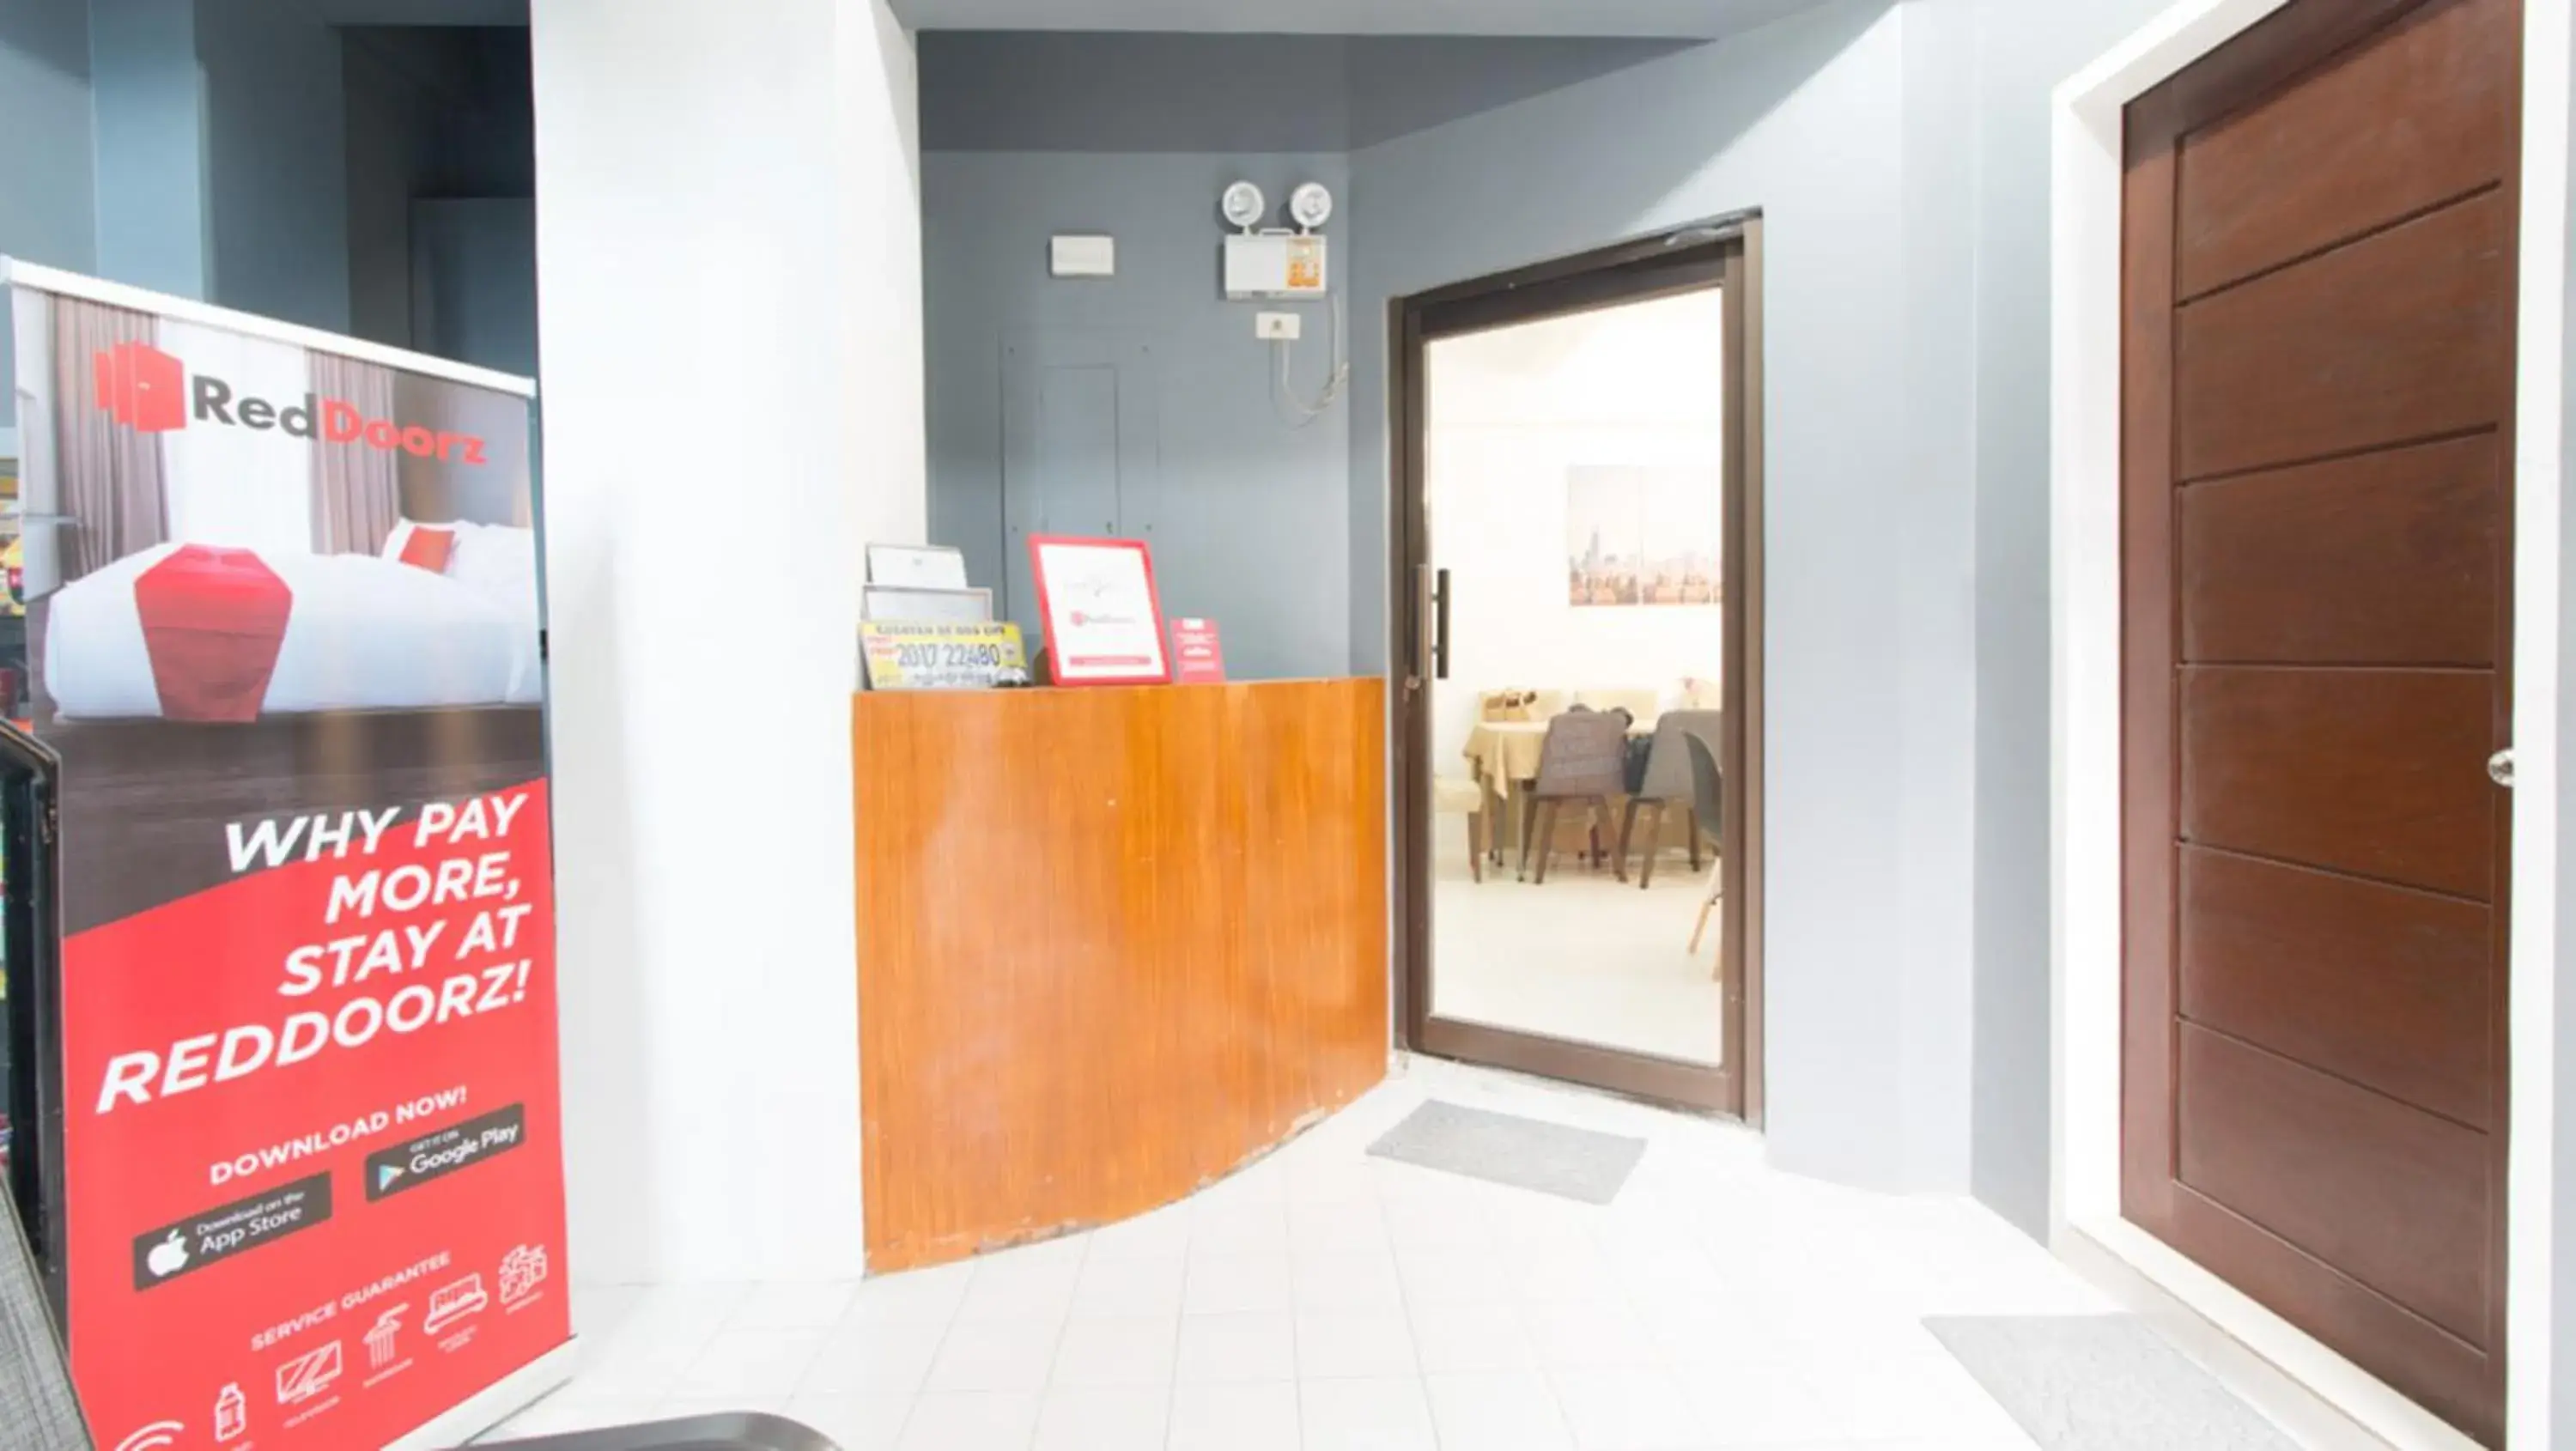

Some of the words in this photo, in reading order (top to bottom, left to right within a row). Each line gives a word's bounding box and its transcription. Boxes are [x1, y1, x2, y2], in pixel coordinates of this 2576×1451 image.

[193, 375, 487, 464] RedDoorz
[226, 805, 401, 873] WHY
[415, 792, 529, 847] PAY
[325, 852, 521, 924] MORE,
[277, 920, 445, 997] STAY
[457, 904, 532, 960] AT
[95, 960, 532, 1114] REDDOORZ!
[210, 1111, 389, 1186] DOWNLOAD
[396, 1085, 467, 1124] NOW!
[410, 1138, 479, 1174] Google
[481, 1124, 519, 1149] Play
[200, 1229, 245, 1255] App
[249, 1207, 302, 1236] Store
[251, 1301, 337, 1351] SERVICE
[341, 1250, 451, 1310] GUARANTEE
